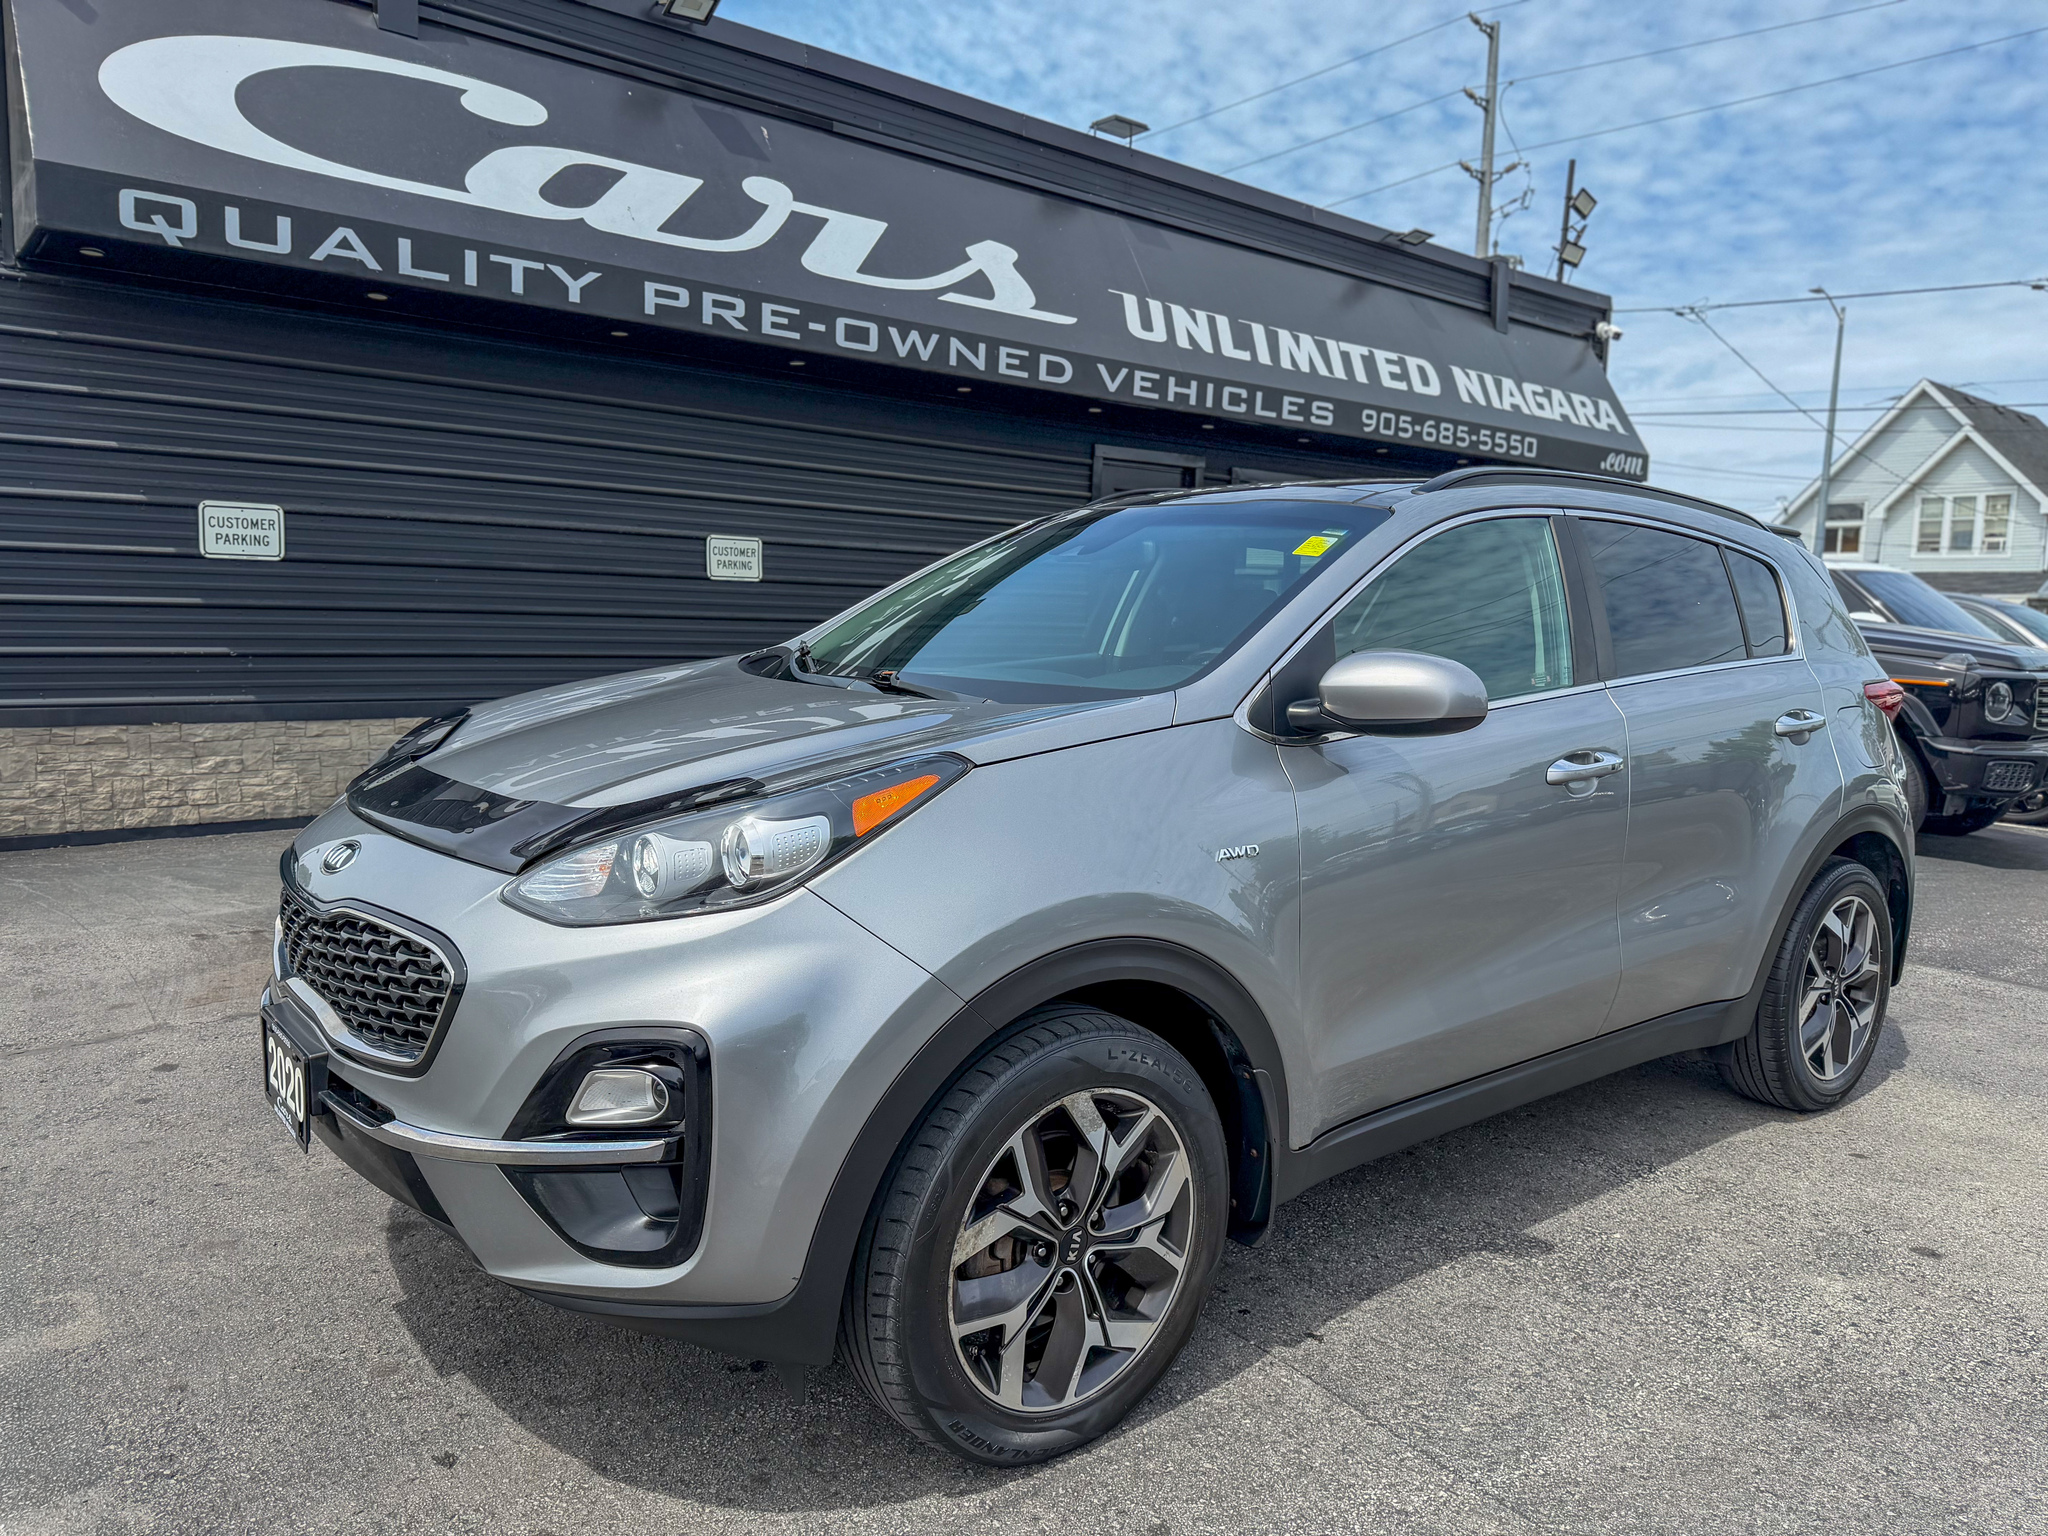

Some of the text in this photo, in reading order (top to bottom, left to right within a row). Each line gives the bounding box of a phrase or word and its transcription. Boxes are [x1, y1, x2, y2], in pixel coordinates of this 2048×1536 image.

[98, 34, 1079, 325] Cars
[118, 188, 1334, 426] QUALITY PRE-OWNED VEHICLES
[1108, 288, 1630, 436] UNLIMITED NIAGARA
[1361, 409, 1538, 458] 905-685-5550
[208, 515, 276, 531] CUSTOMER
[215, 532, 270, 547] PARKING
[712, 545, 757, 558] CUSTOMER
[716, 559, 753, 571] PARKING
[1215, 844, 1260, 862] AWD
[268, 1036, 304, 1123] 2020
[1066, 1230, 1083, 1261] KIA
